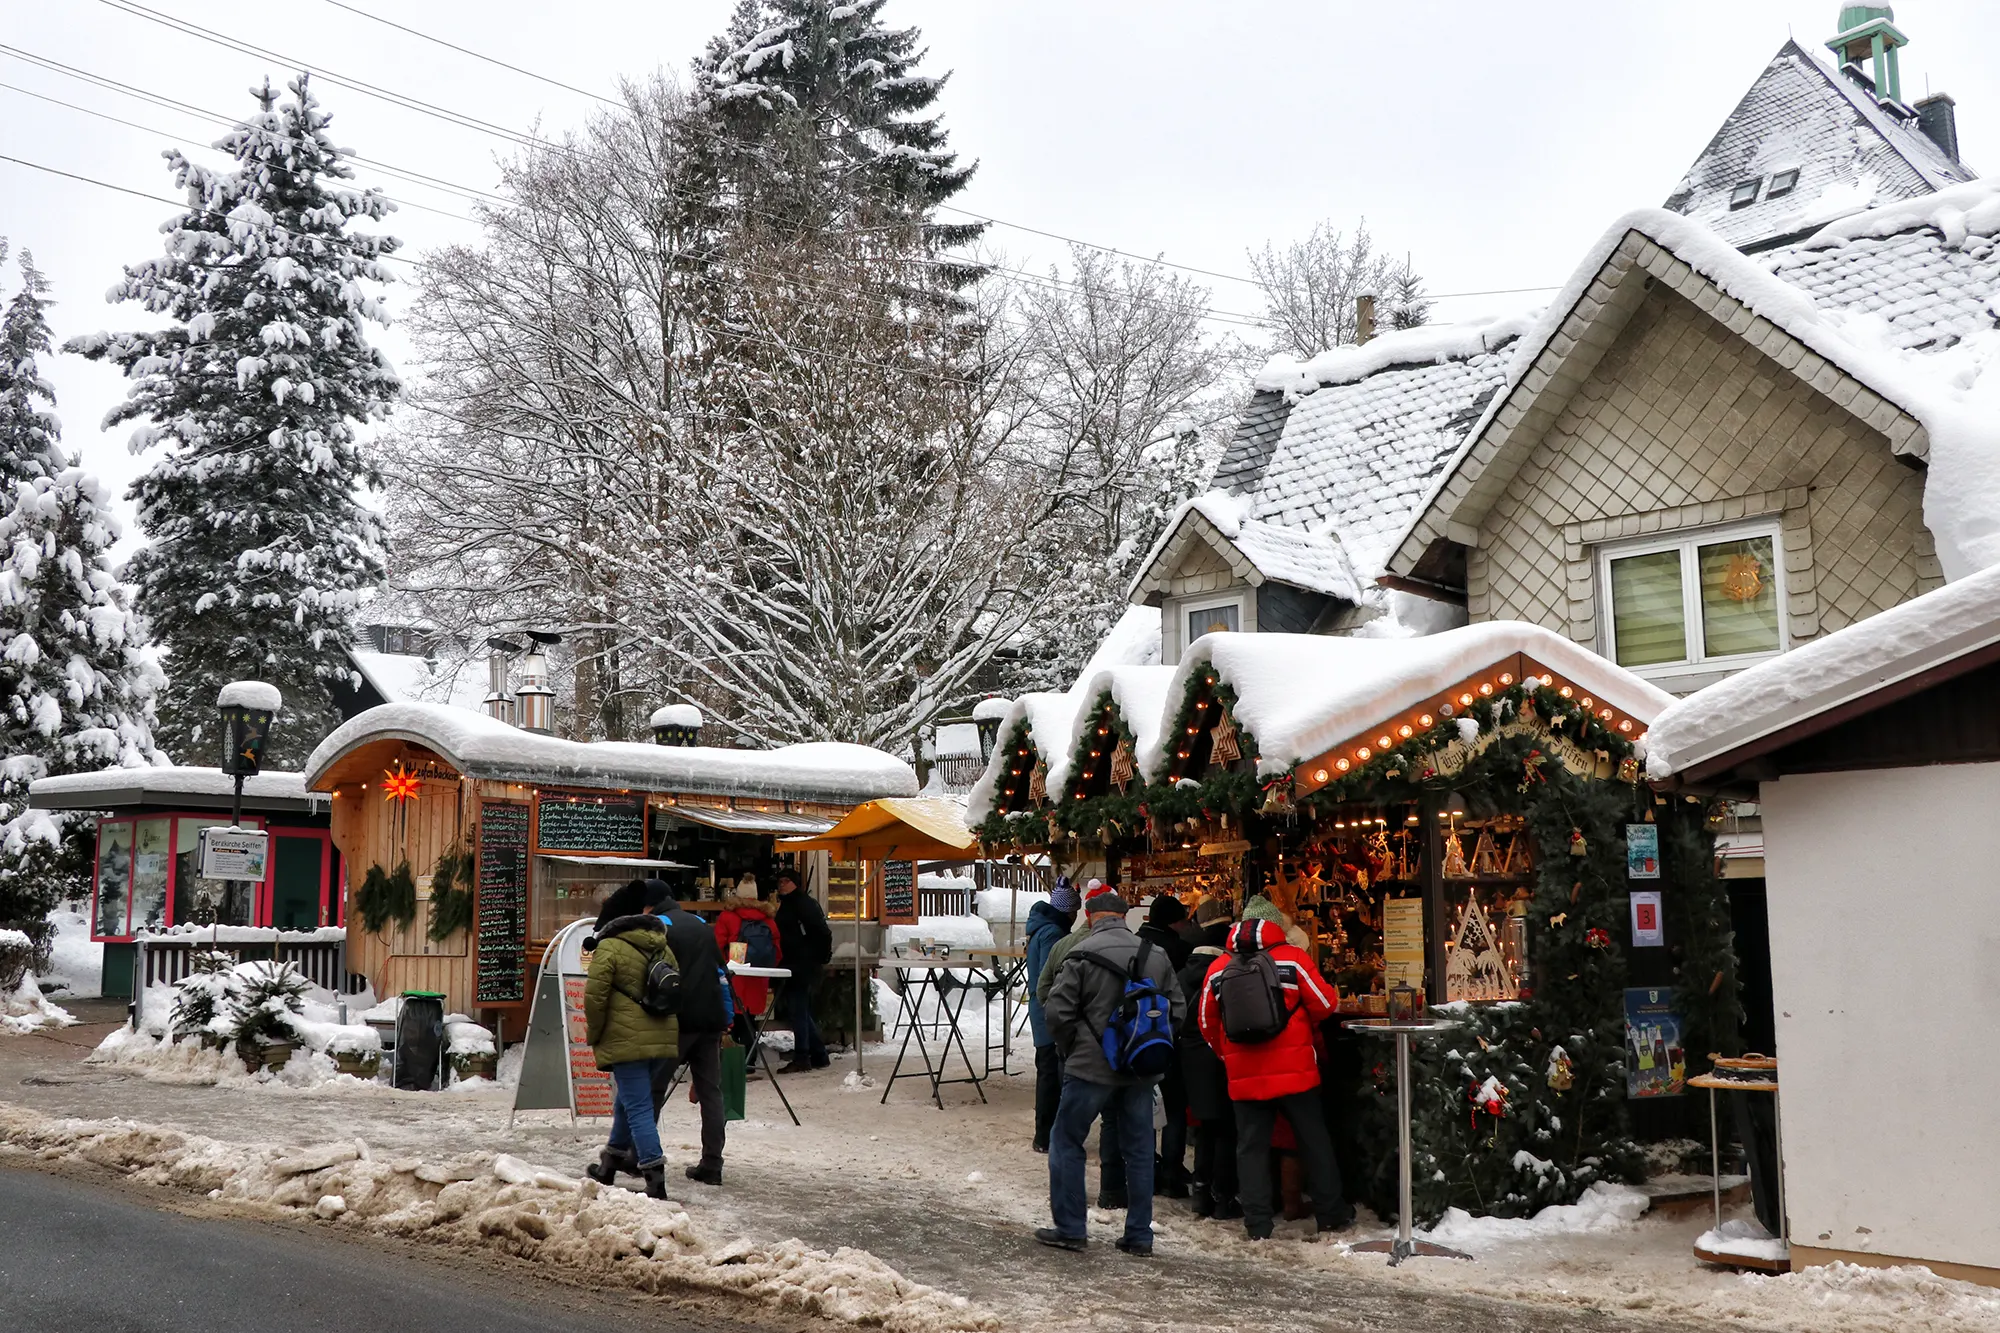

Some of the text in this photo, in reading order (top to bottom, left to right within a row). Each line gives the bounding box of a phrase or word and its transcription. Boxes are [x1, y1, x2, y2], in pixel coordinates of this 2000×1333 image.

[1552, 736, 1589, 771] Seiffen
[242, 841, 262, 849] Seiffen
[1644, 910, 1650, 924] 3
[582, 1072, 610, 1080] Brotteig
